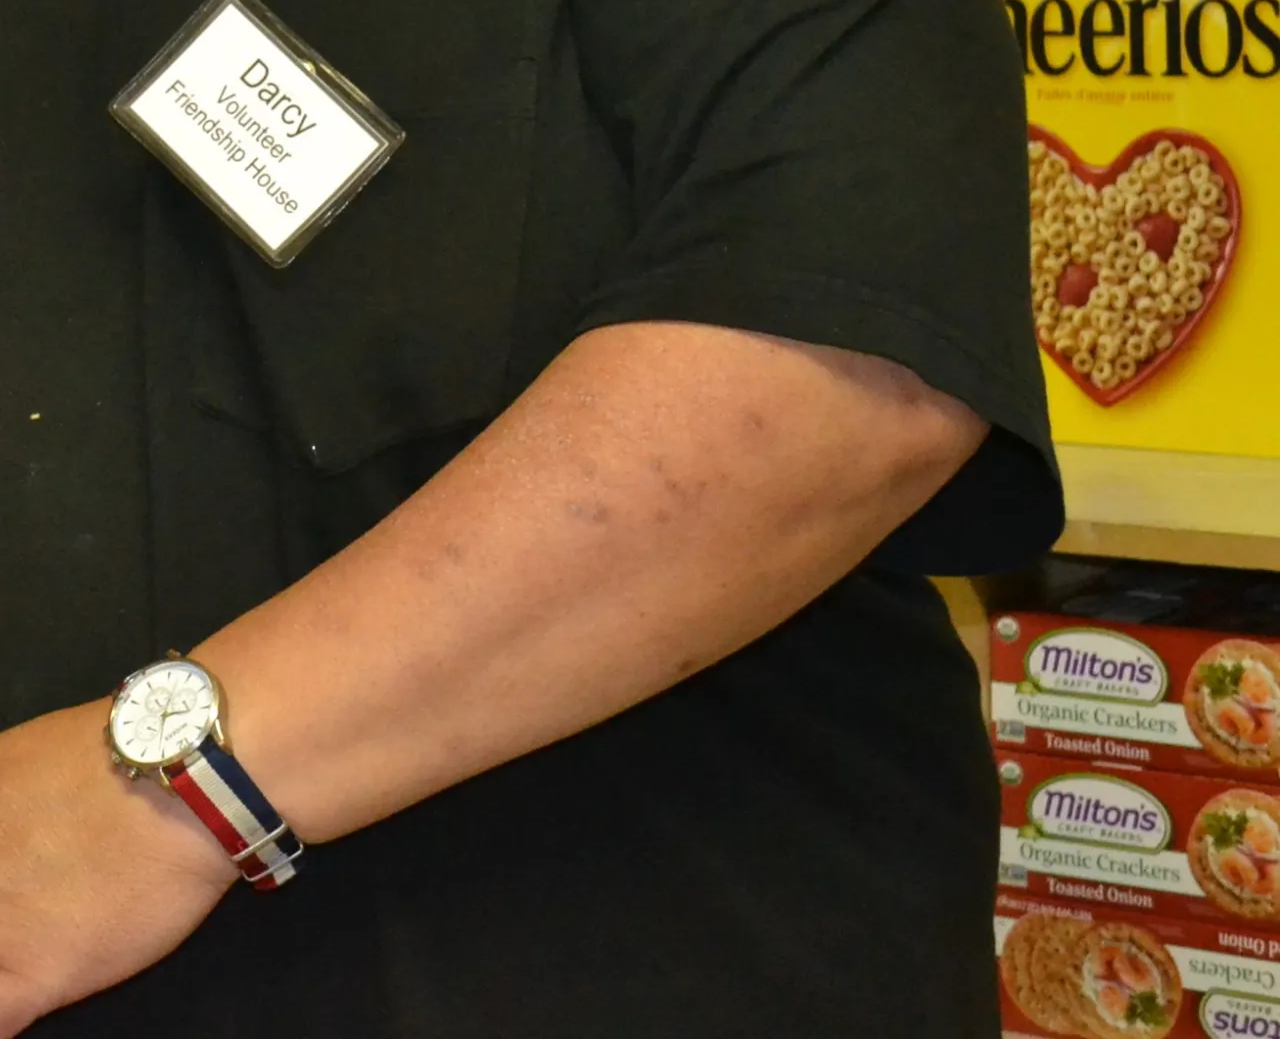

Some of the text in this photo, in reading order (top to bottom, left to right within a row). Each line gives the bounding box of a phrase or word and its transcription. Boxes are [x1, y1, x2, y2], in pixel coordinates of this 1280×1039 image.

[239, 58, 317, 140] Darcy
[216, 85, 293, 164] Volunteer
[165, 79, 299, 214] Friendship House
[1018, 697, 1178, 735] Organic Crackers
[1044, 732, 1151, 761] Toasted Onion
[1020, 842, 1181, 883] Organic Crackers
[1046, 877, 1154, 909] Toasted Onion
[1218, 932, 1265, 954] Onion
[1189, 959, 1276, 990] Crackers
